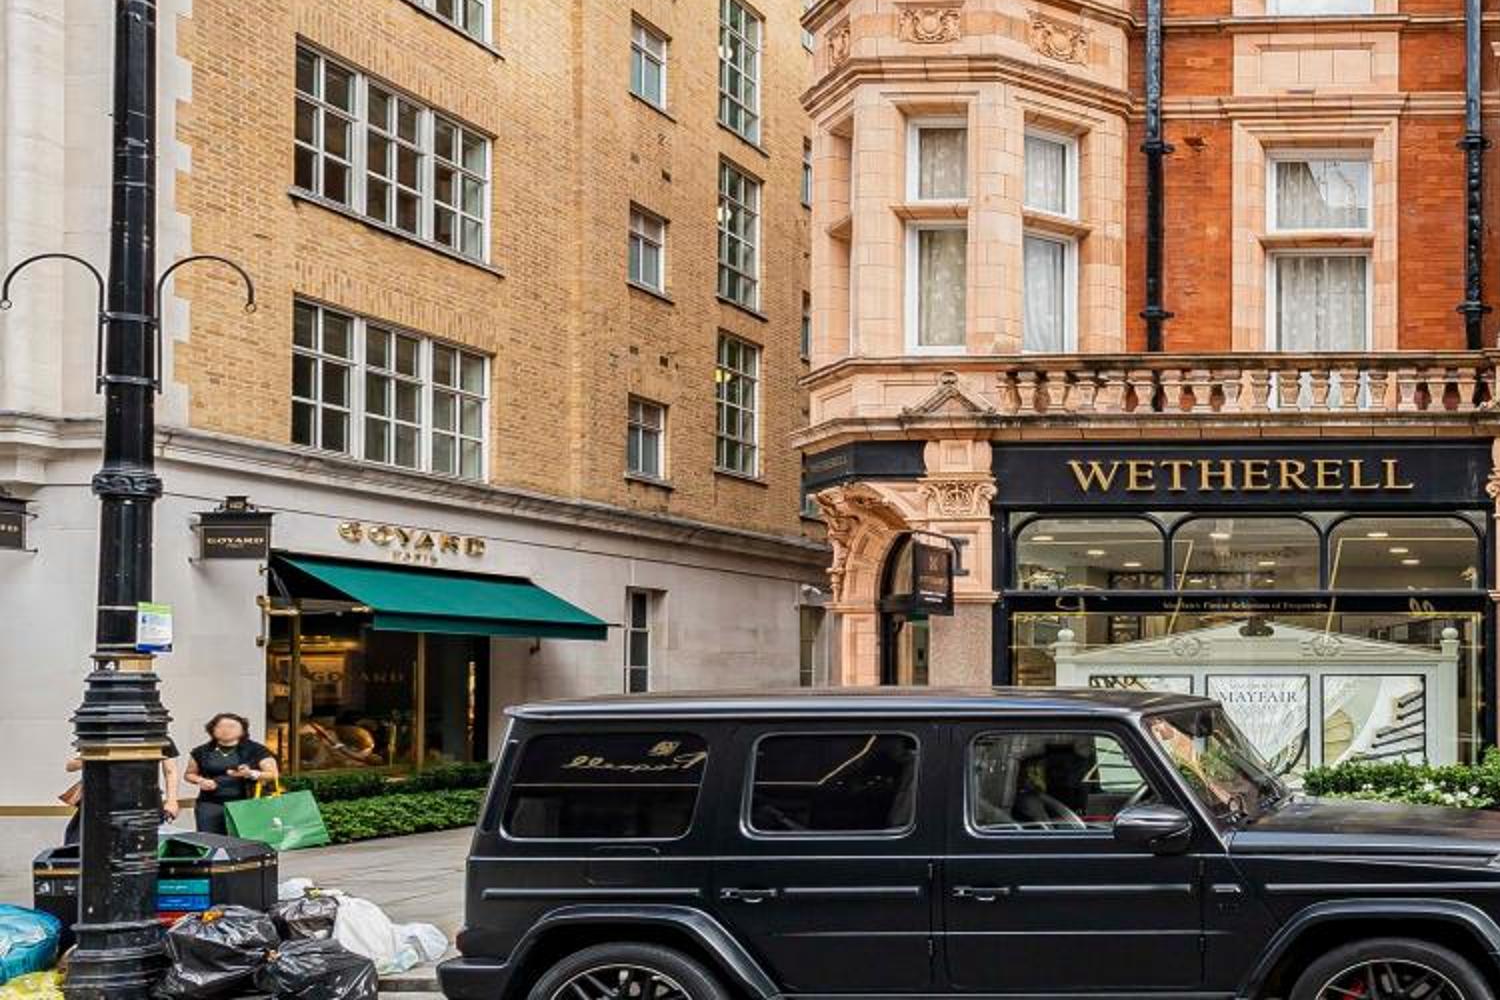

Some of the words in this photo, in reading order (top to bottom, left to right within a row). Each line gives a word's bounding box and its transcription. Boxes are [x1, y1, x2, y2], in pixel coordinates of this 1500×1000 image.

[1065, 458, 1415, 492] WETHERELL
[206, 537, 264, 545] GOYARD
[337, 520, 486, 557] GOYARD
[1219, 691, 1298, 703] MAYFAIR
